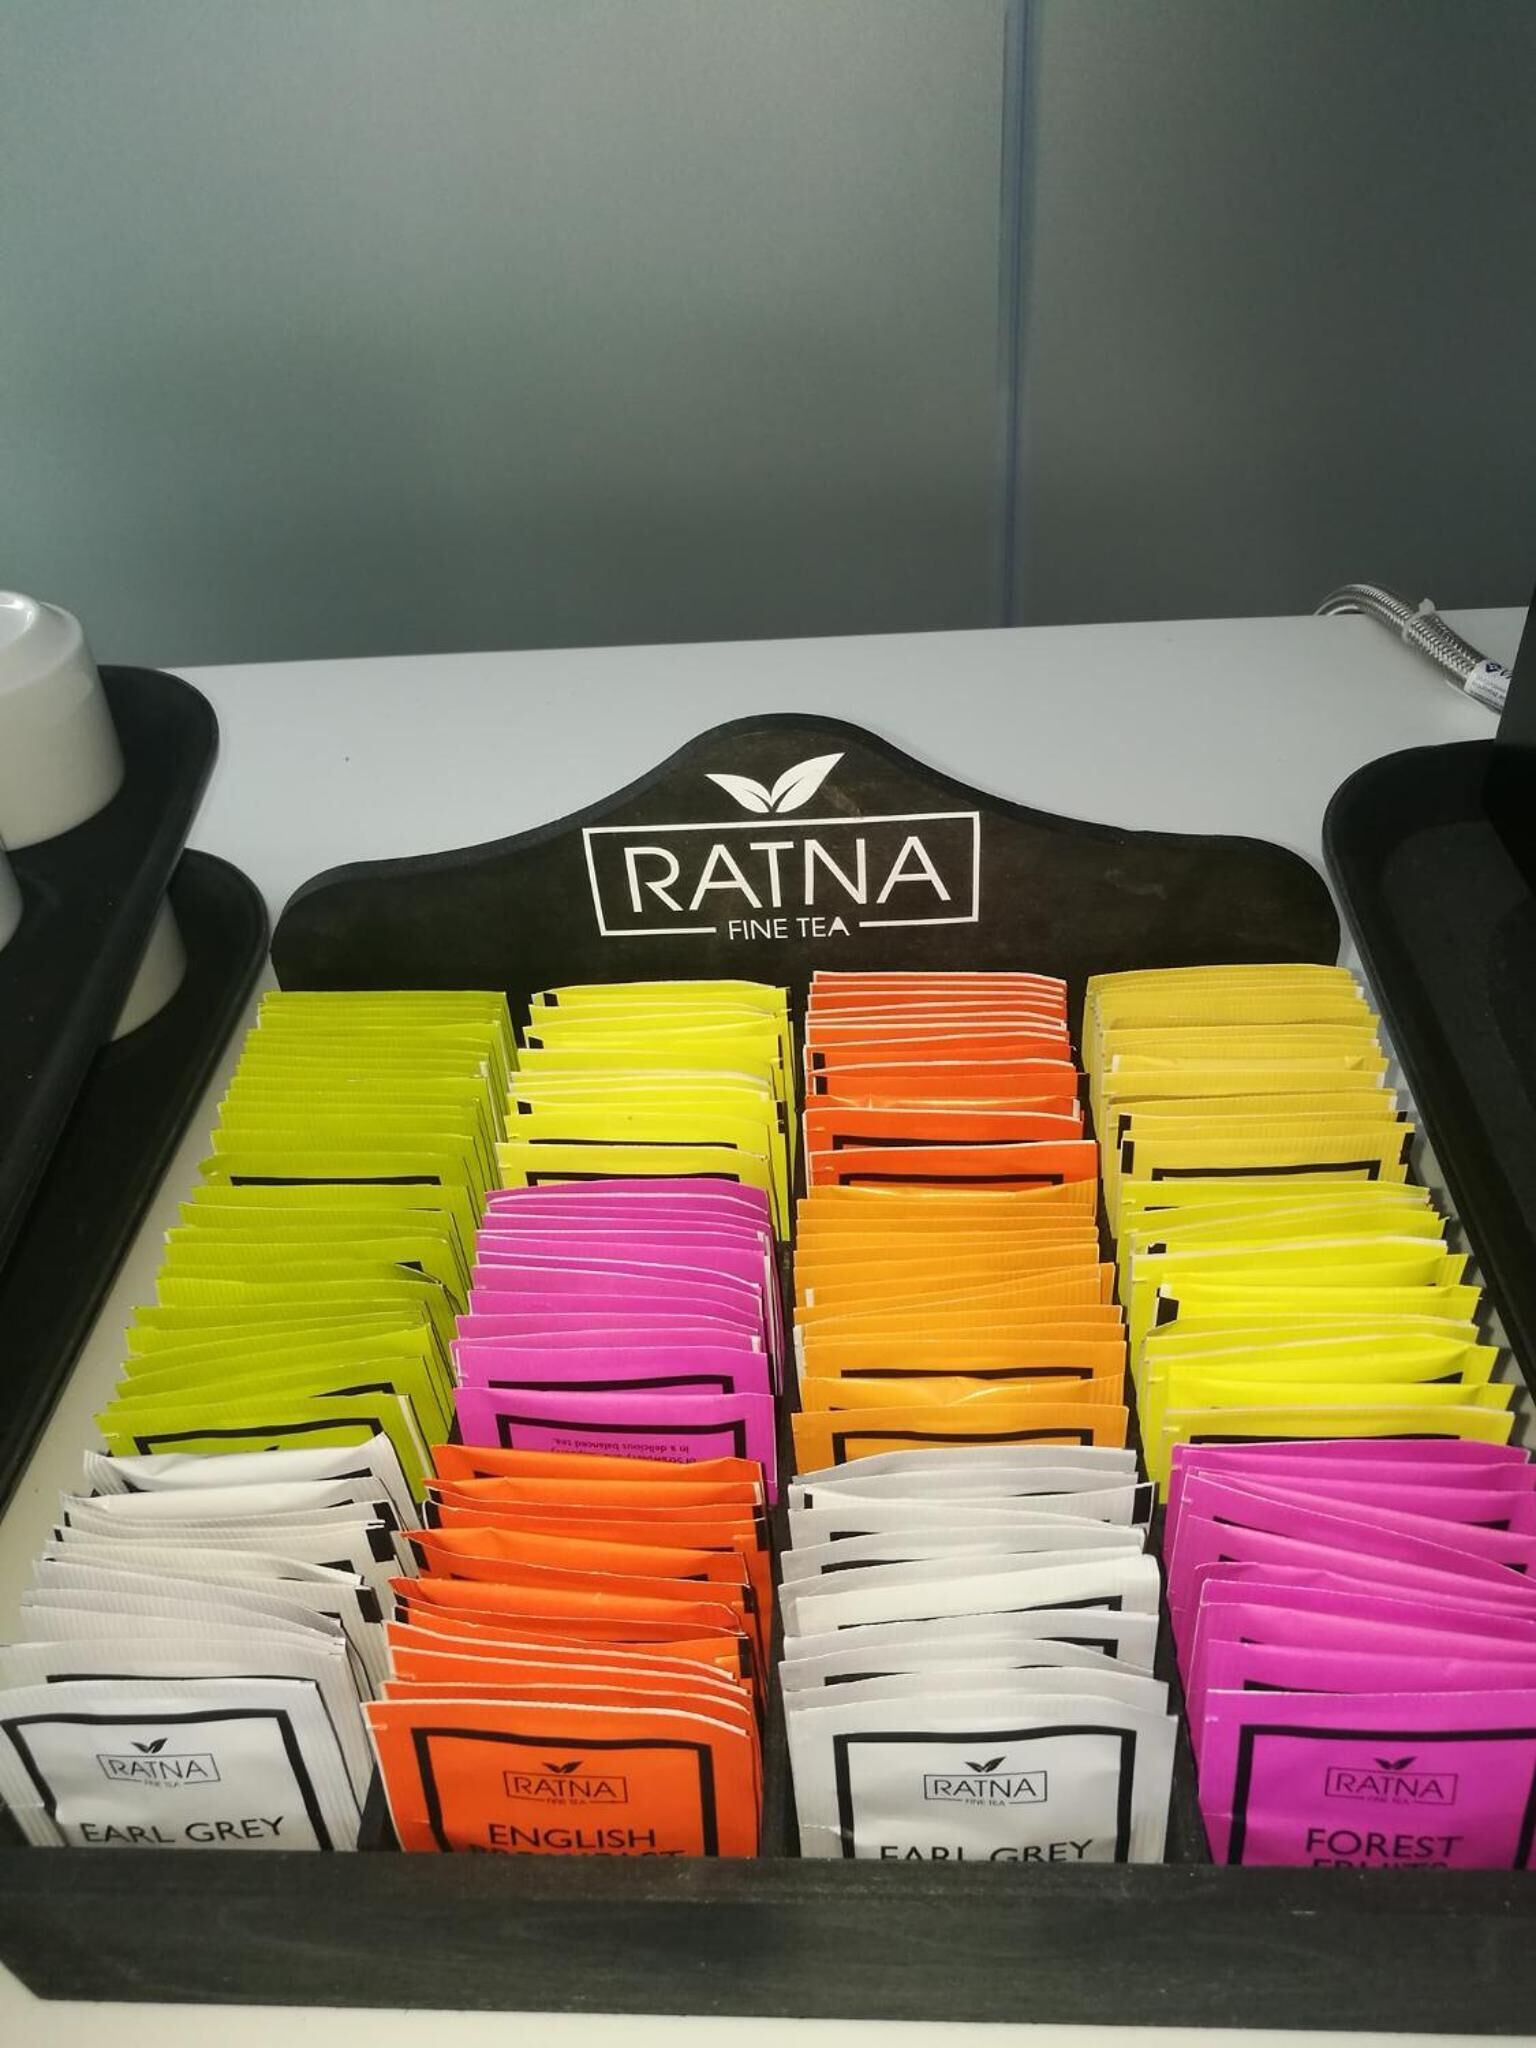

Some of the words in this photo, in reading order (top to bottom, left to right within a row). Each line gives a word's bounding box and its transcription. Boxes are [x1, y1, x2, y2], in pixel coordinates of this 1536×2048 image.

[624, 836, 951, 913] RATNA
[728, 918, 788, 941] FINE
[796, 916, 850, 938] TEA
[108, 1758, 208, 1779] RATNA
[513, 1776, 616, 1798] RATNA
[934, 1777, 1037, 1798] RATNA
[1336, 1772, 1444, 1799] RATNA
[80, 1822, 175, 1844] EARL
[185, 1816, 284, 1843] GREY
[488, 1823, 656, 1849] ENGLISH
[1305, 1828, 1464, 1858] FOREST
